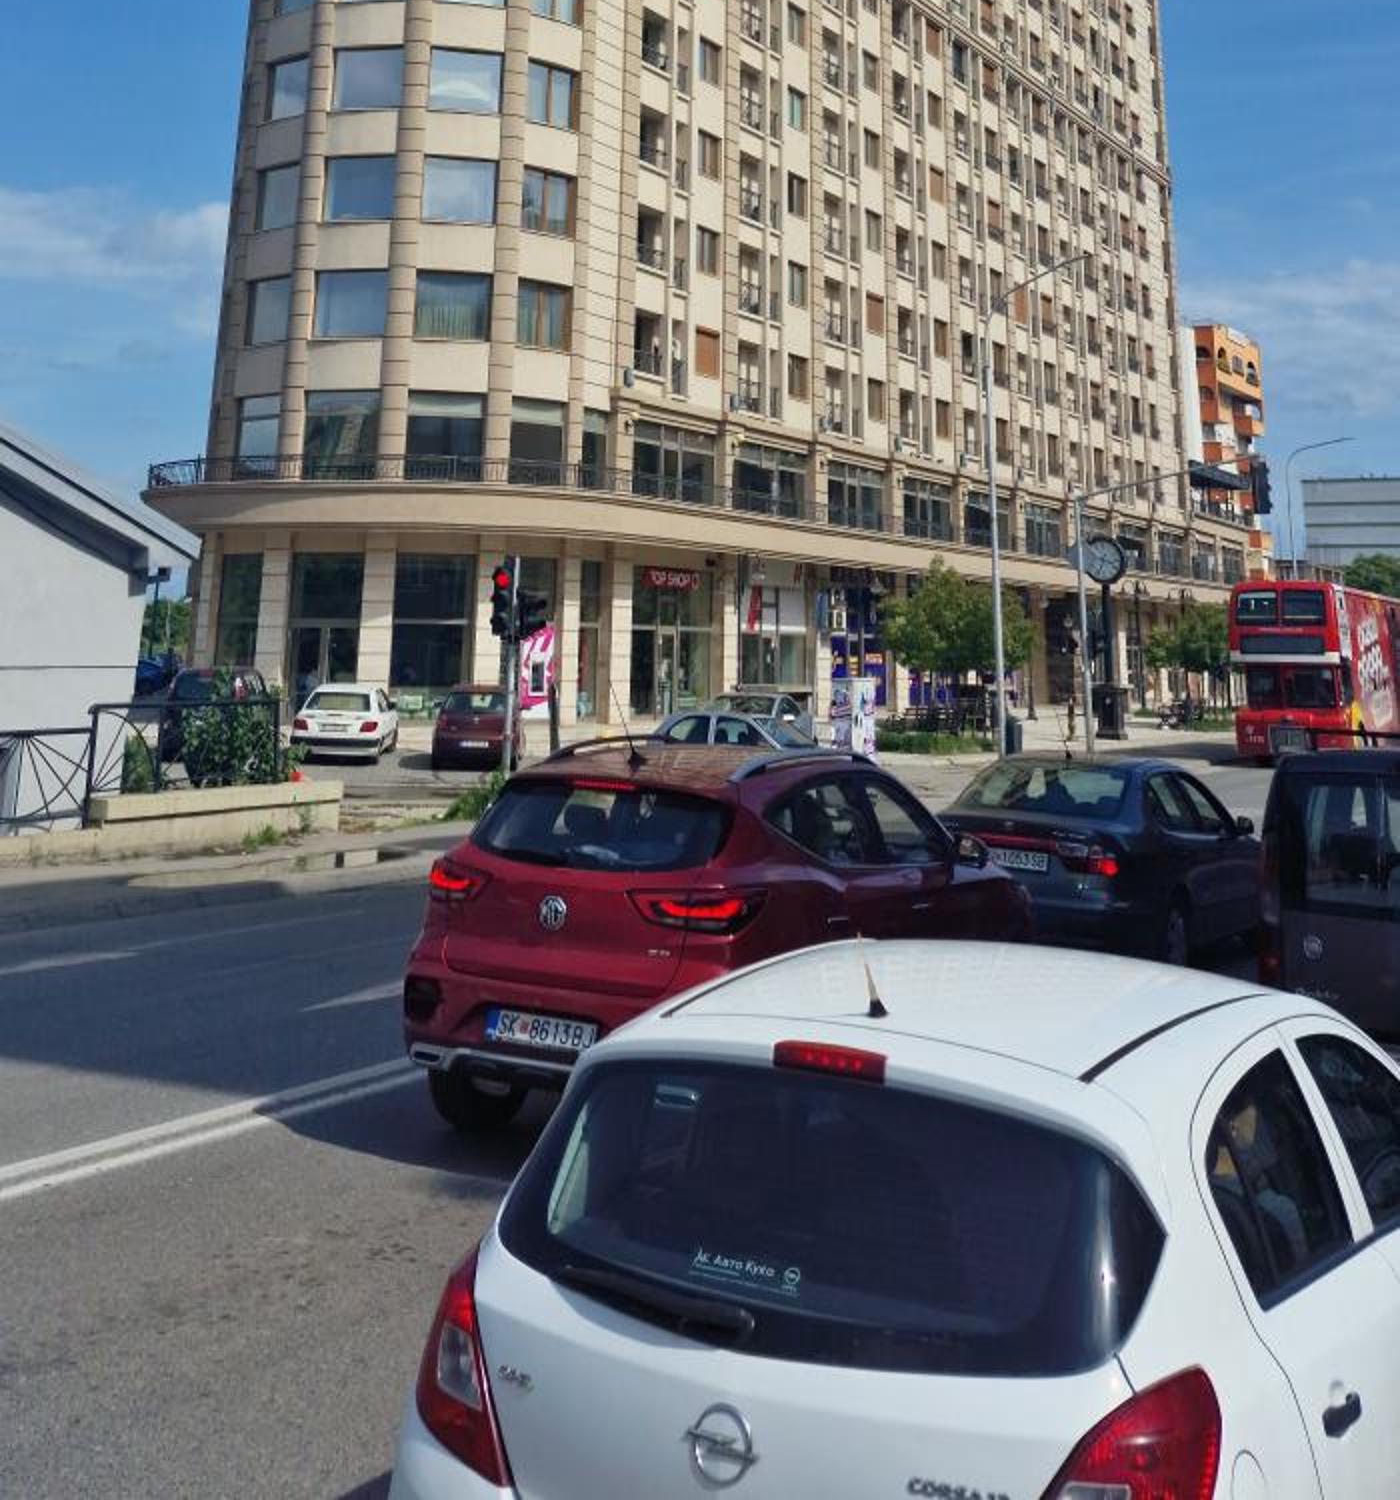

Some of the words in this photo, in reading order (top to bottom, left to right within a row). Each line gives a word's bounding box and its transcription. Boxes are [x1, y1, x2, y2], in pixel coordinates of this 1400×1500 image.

[651, 570, 667, 586] TOP
[667, 573, 690, 588] SHOP
[498, 1013, 519, 1037] SK
